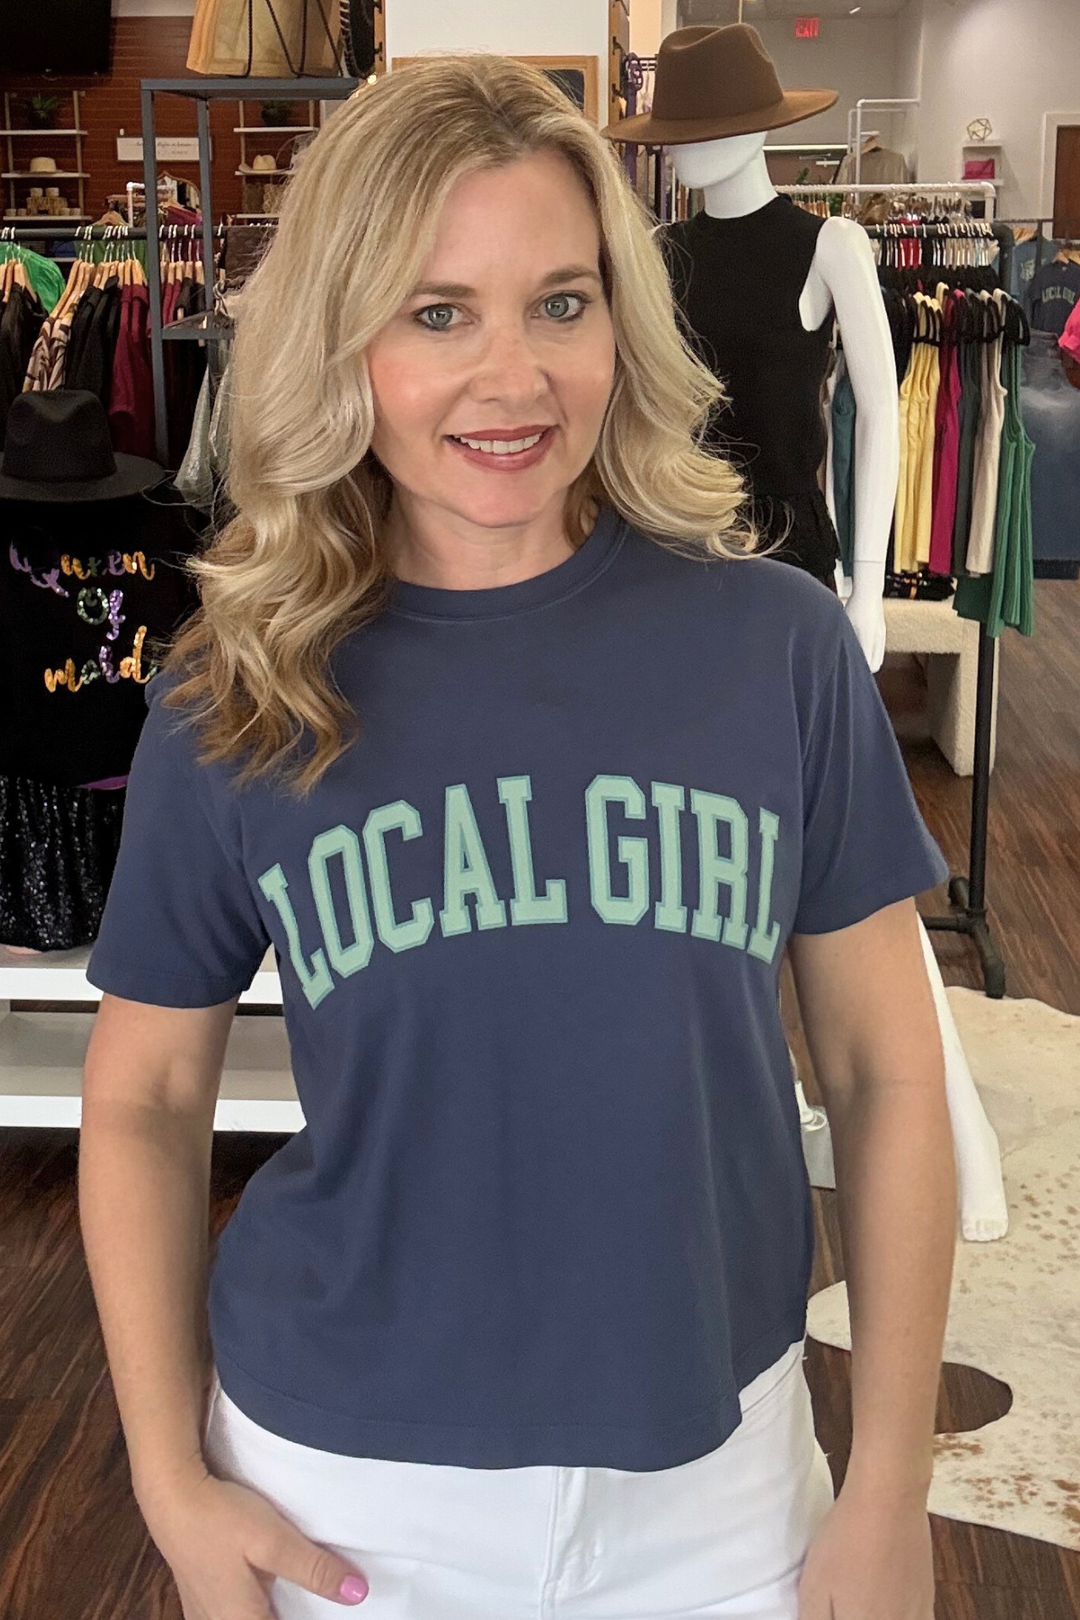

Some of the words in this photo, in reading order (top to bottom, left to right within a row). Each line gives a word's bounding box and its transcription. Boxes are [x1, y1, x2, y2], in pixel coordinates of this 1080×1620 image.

[795, 17, 819, 38] EXIT
[257, 774, 568, 1011] LOCAL
[585, 774, 781, 965] GIRL
